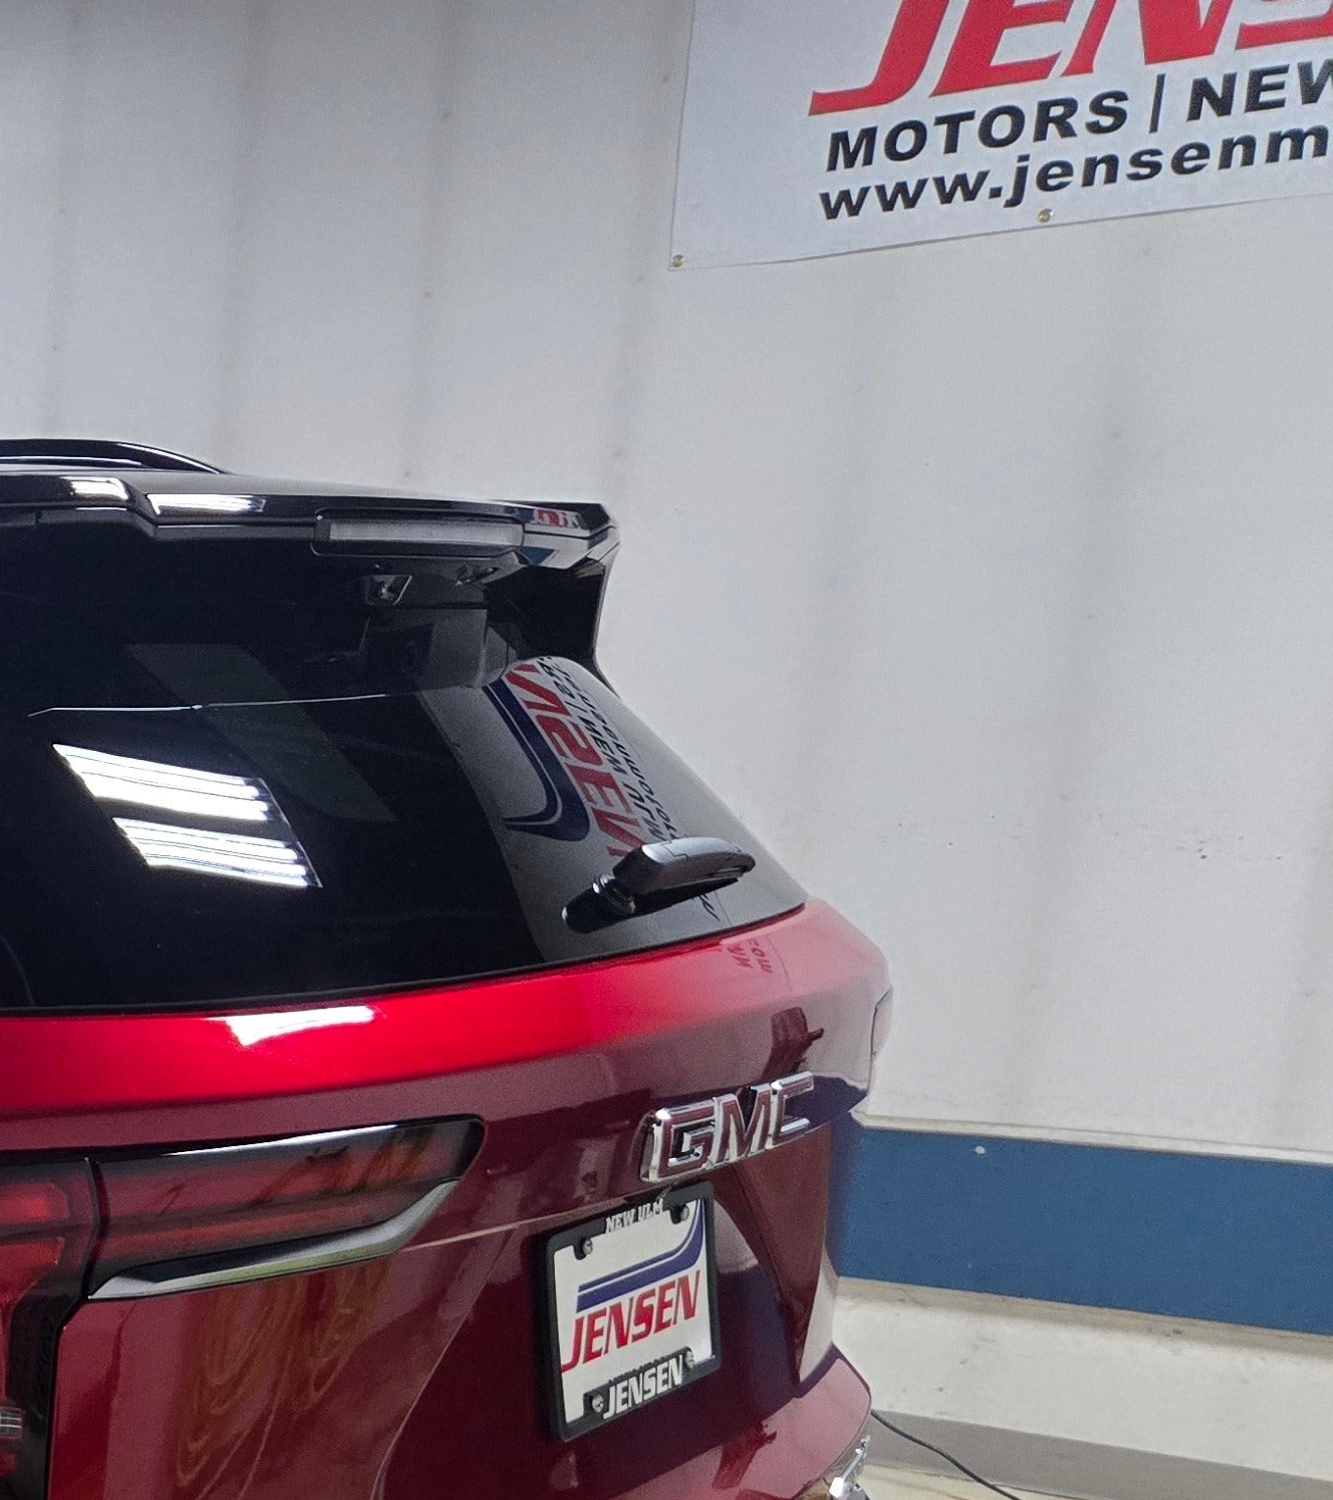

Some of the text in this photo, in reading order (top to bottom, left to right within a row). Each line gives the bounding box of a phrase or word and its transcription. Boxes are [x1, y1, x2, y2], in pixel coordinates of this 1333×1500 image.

[818, 125, 1329, 221] www.jensenm
[826, 89, 1130, 172] MOTORS
[639, 1070, 815, 1184] GMC
[606, 1208, 636, 1234] NEW
[560, 1269, 700, 1373] JENSEN
[602, 1354, 683, 1420] JENSEN
